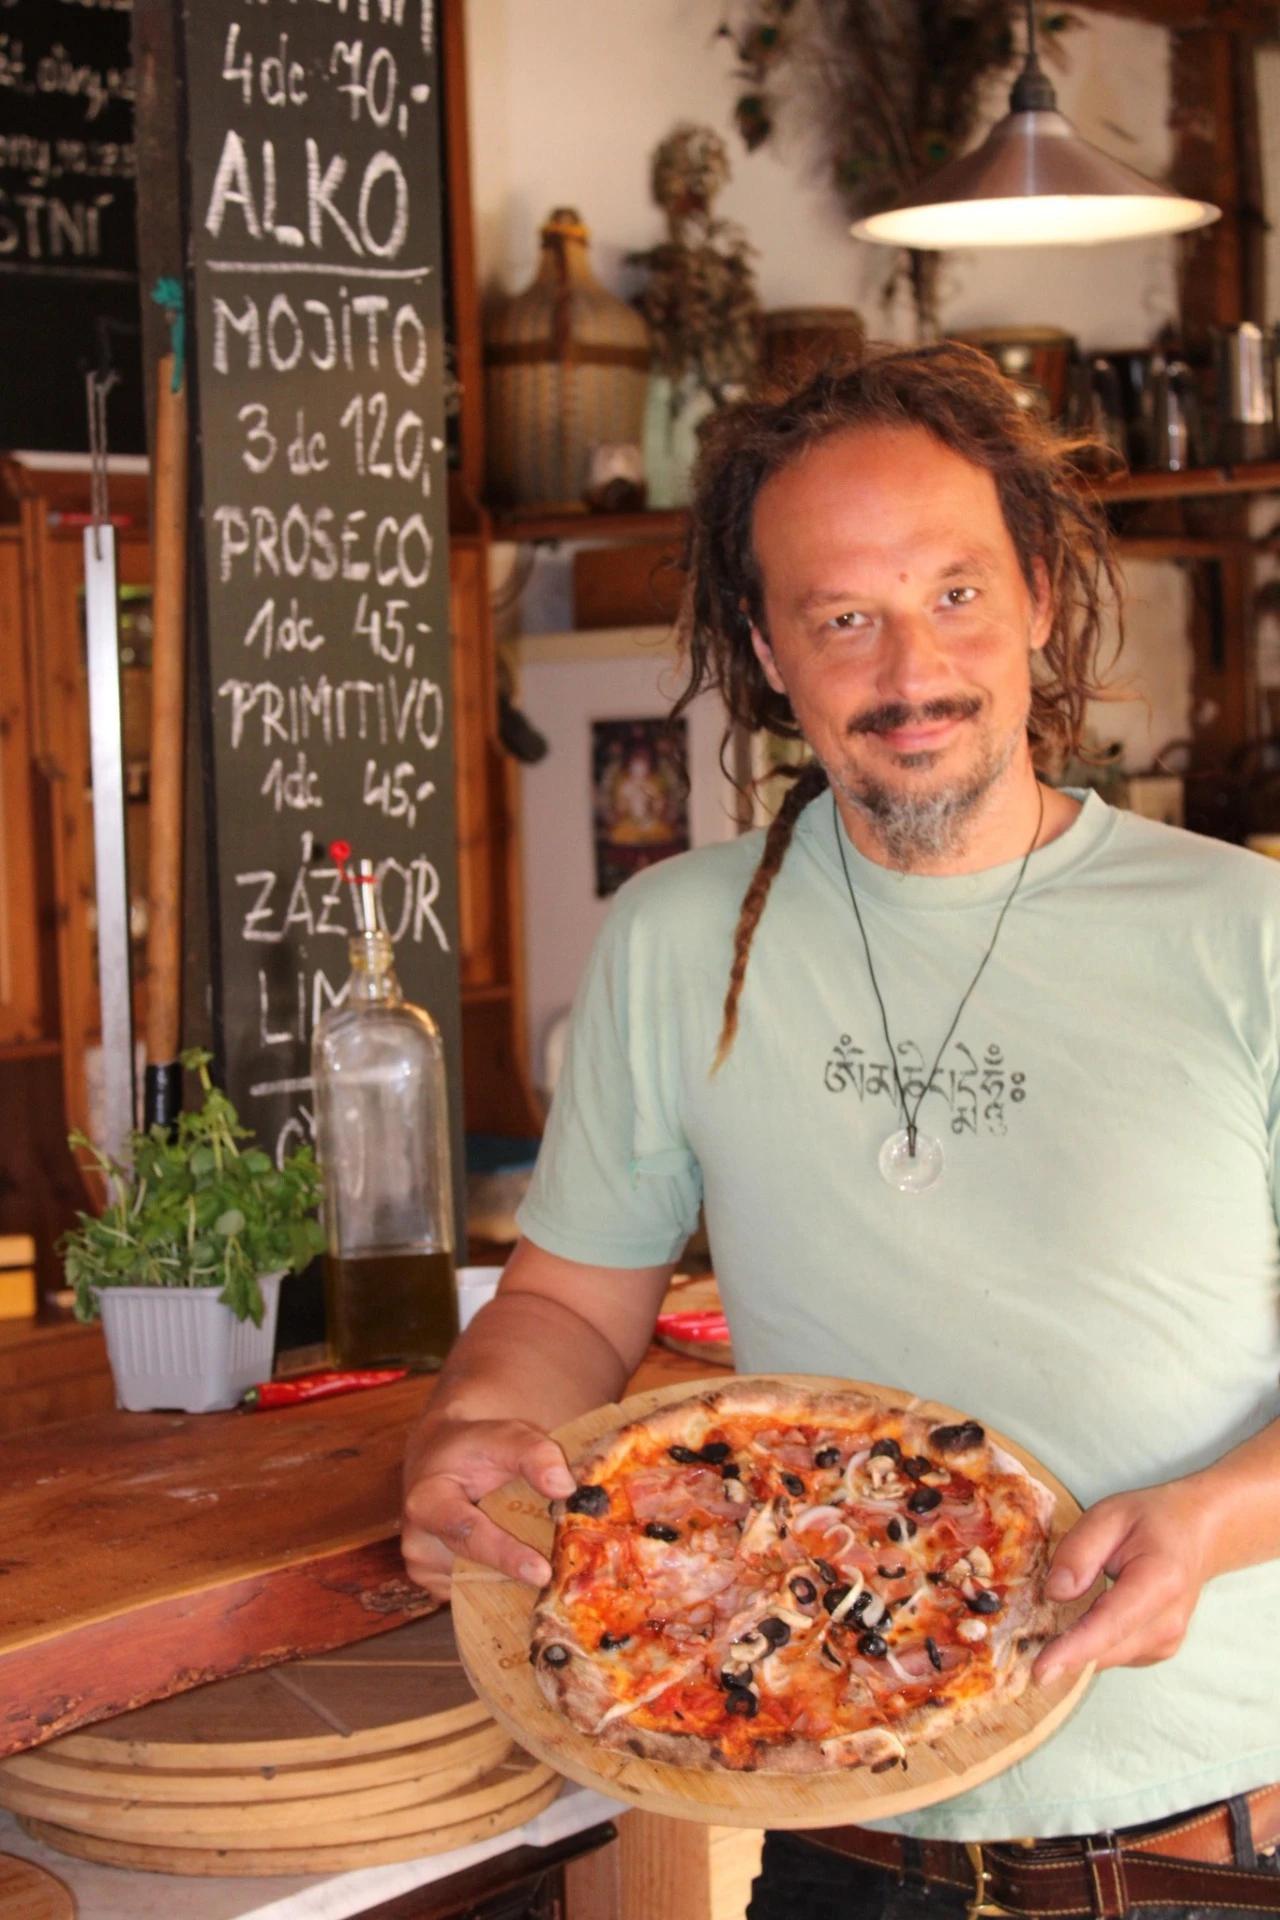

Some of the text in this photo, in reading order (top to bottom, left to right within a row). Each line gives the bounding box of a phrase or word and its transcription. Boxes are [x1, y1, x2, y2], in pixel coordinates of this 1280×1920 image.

[205, 130, 408, 259] ALKO
[237, 403, 278, 474] 3
[287, 409, 330, 476] dc
[213, 503, 432, 589] PROSECO
[218, 674, 443, 750] PRIMITIVO
